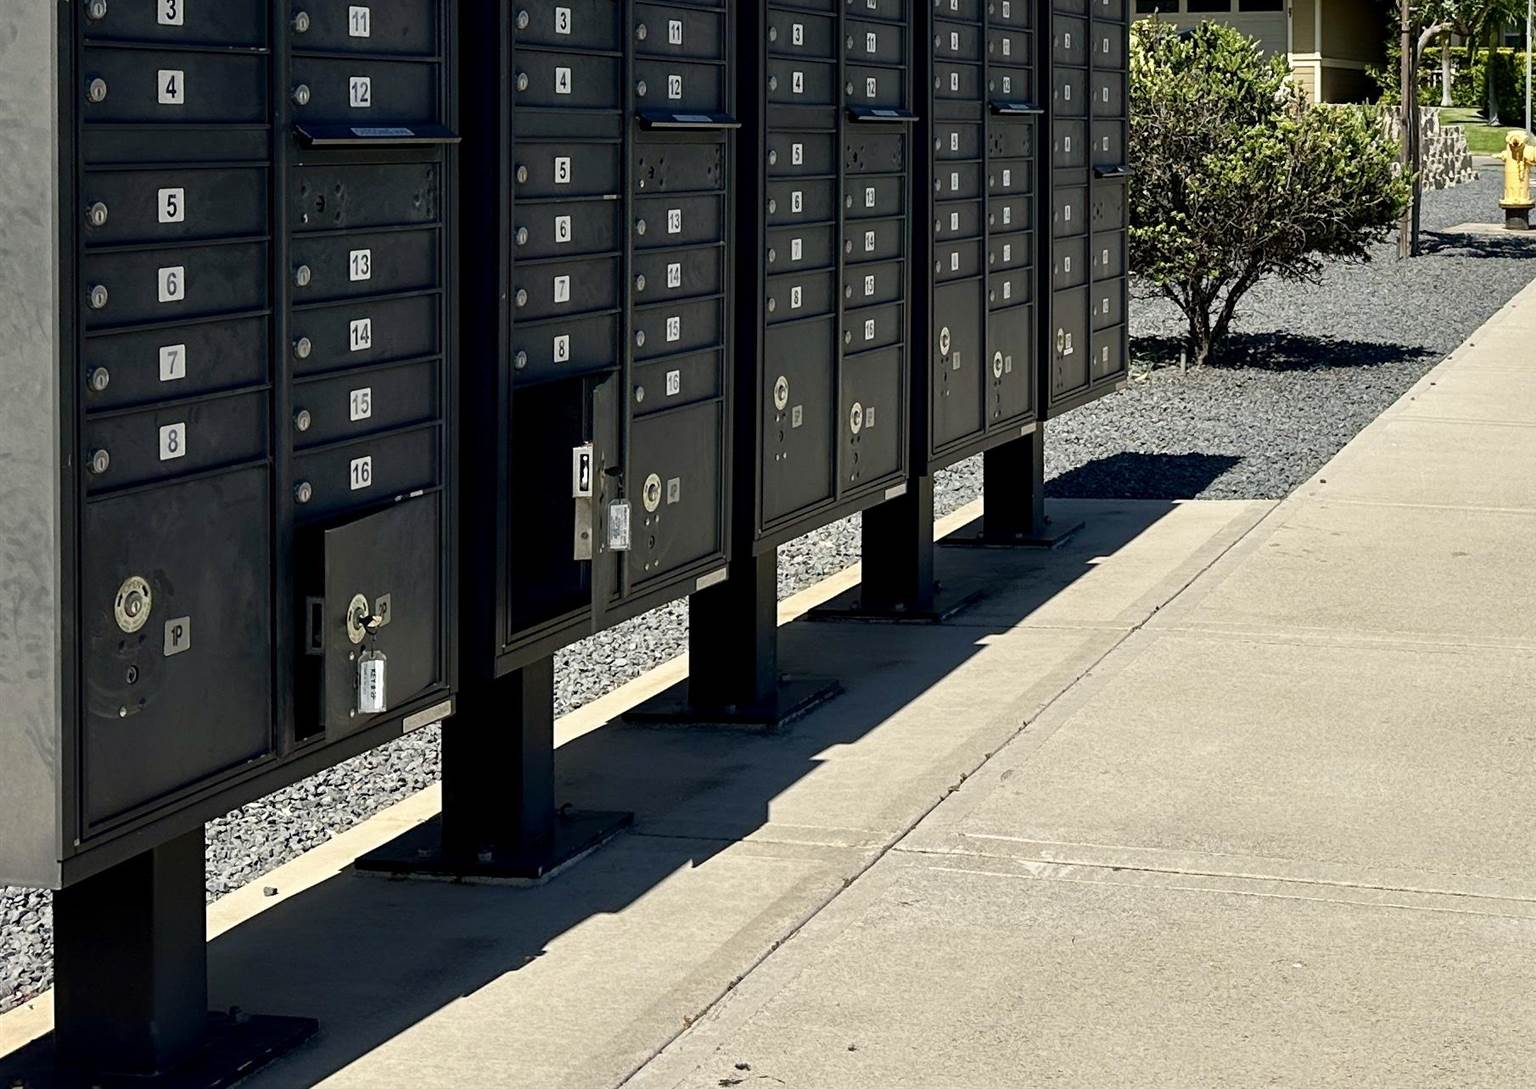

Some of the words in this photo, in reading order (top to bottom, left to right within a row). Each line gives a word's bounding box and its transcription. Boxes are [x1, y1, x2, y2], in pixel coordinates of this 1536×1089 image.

[353, 11, 366, 32] 11
[560, 12, 567, 30] 3
[671, 24, 679, 40] 11
[796, 27, 801, 41] 3
[868, 36, 875, 50] 11
[166, 75, 177, 98] 4
[560, 72, 567, 89] 4
[670, 79, 680, 95] 12
[796, 76, 801, 89] 4
[867, 81, 875, 95] 12
[352, 82, 368, 102] 12
[795, 147, 800, 161] 5
[560, 162, 567, 179] 5
[167, 194, 177, 217] 5
[795, 195, 800, 209] 6
[560, 221, 567, 238] 6
[670, 214, 679, 229] 13
[353, 254, 369, 275] 13
[669, 267, 679, 283] 14
[167, 272, 176, 296] 6
[559, 280, 566, 297] 7
[794, 290, 799, 304] 8
[352, 323, 369, 345] 14
[669, 321, 678, 337] 15
[558, 340, 565, 357] 8
[168, 351, 177, 374] 7
[669, 374, 678, 391] 16
[353, 393, 369, 415] 15
[168, 429, 178, 453] 8
[353, 462, 370, 484] 16
[171, 625, 182, 646] 1P
